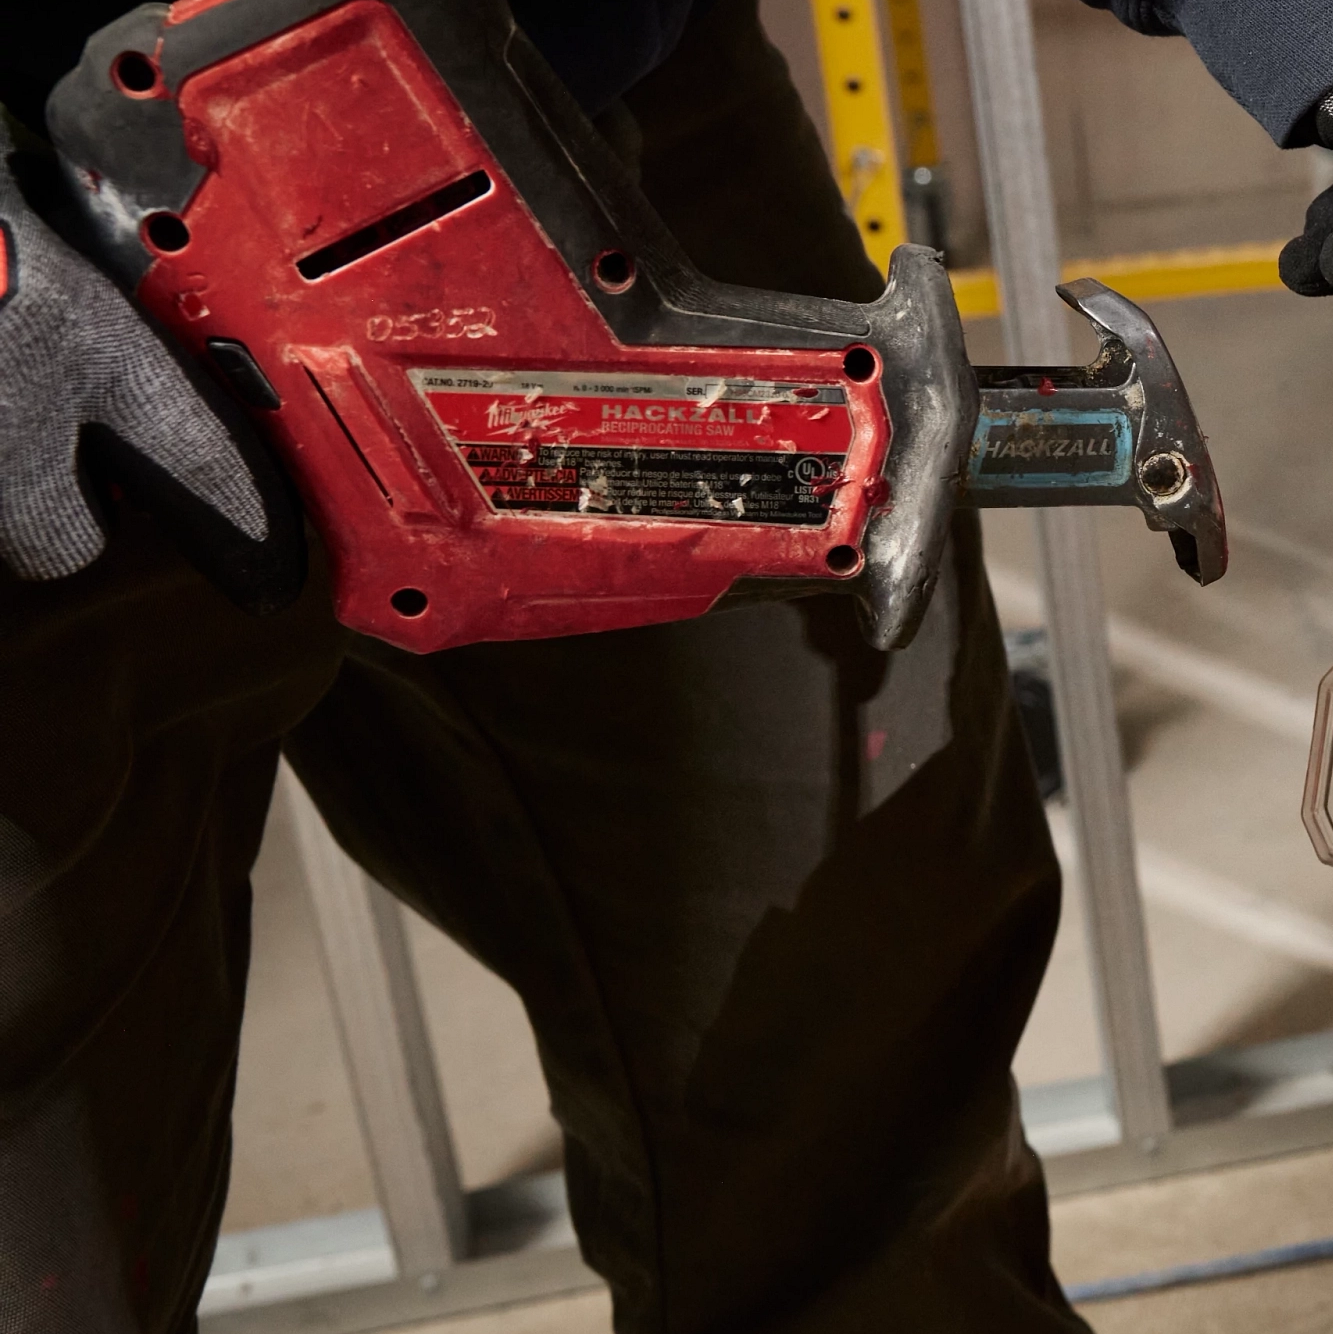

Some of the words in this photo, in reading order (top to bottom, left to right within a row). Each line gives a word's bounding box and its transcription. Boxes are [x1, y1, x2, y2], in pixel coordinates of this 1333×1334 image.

[686, 387, 706, 396] SER.
[602, 404, 763, 424] HACKZALL
[601, 421, 703, 436] RECIPROCATING
[706, 424, 735, 436] SAW
[581, 449, 596, 457] the
[985, 438, 1113, 459] HACKZALL
